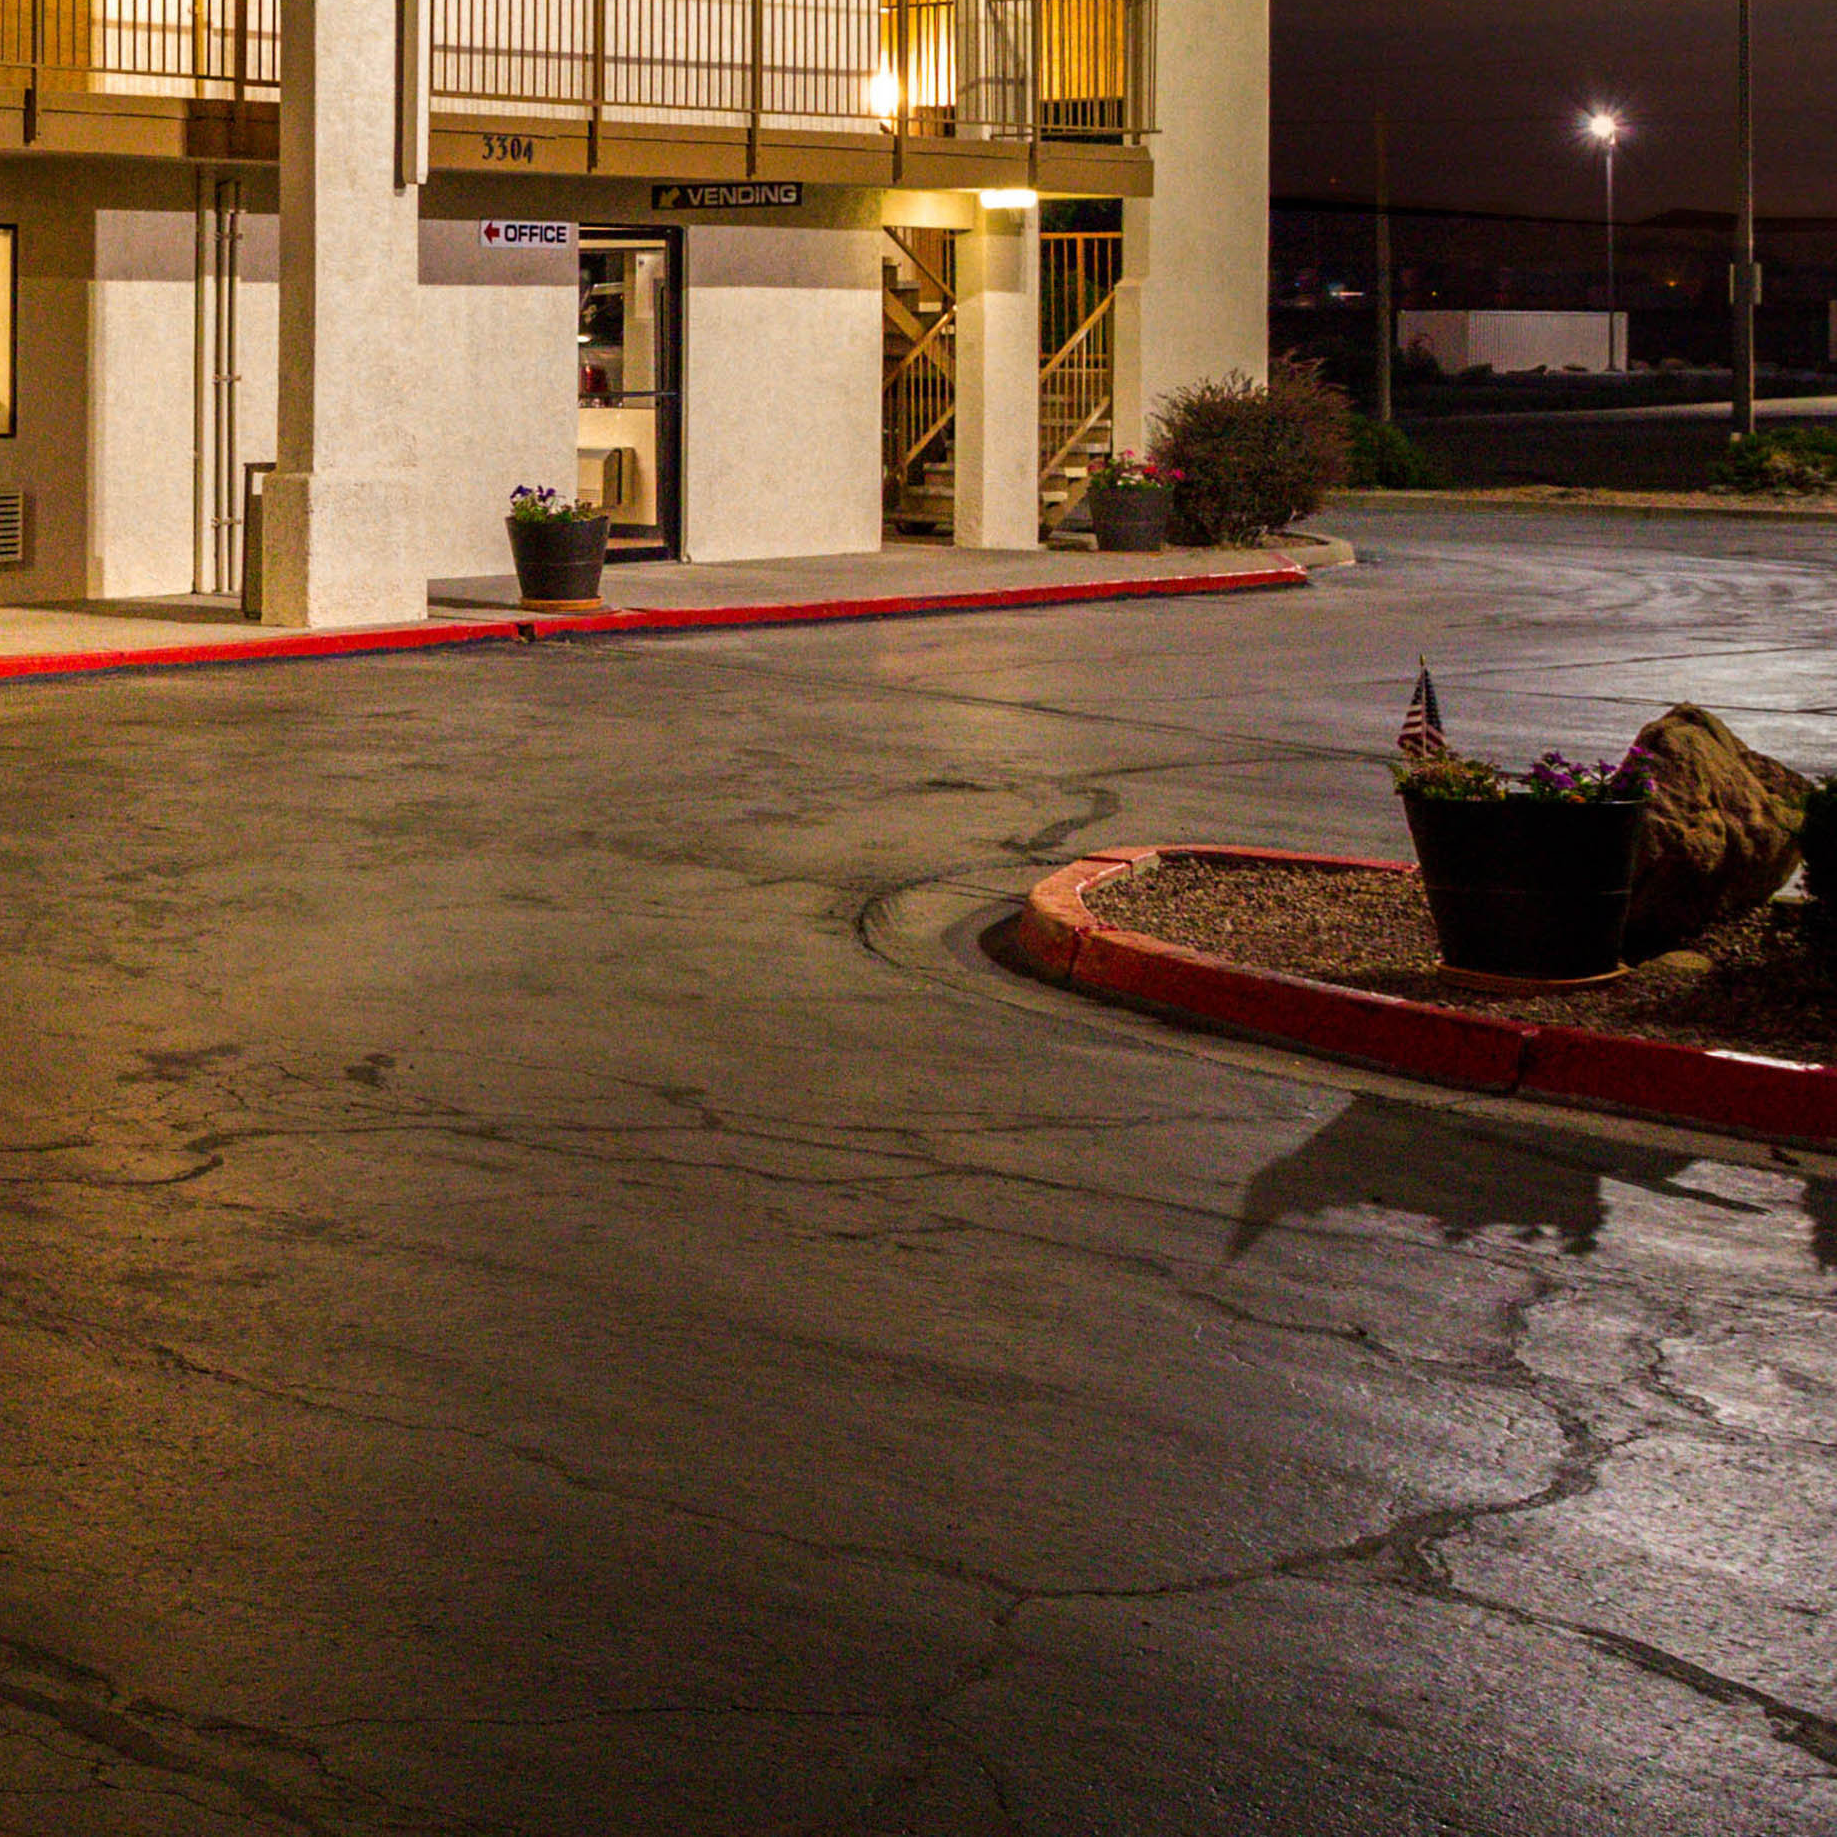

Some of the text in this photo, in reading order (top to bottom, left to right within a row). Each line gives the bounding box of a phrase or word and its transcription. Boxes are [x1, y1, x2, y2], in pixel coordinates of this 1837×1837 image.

[482, 133, 534, 163] 3304
[686, 184, 798, 207] VENDING
[504, 224, 567, 243] OFFICE
